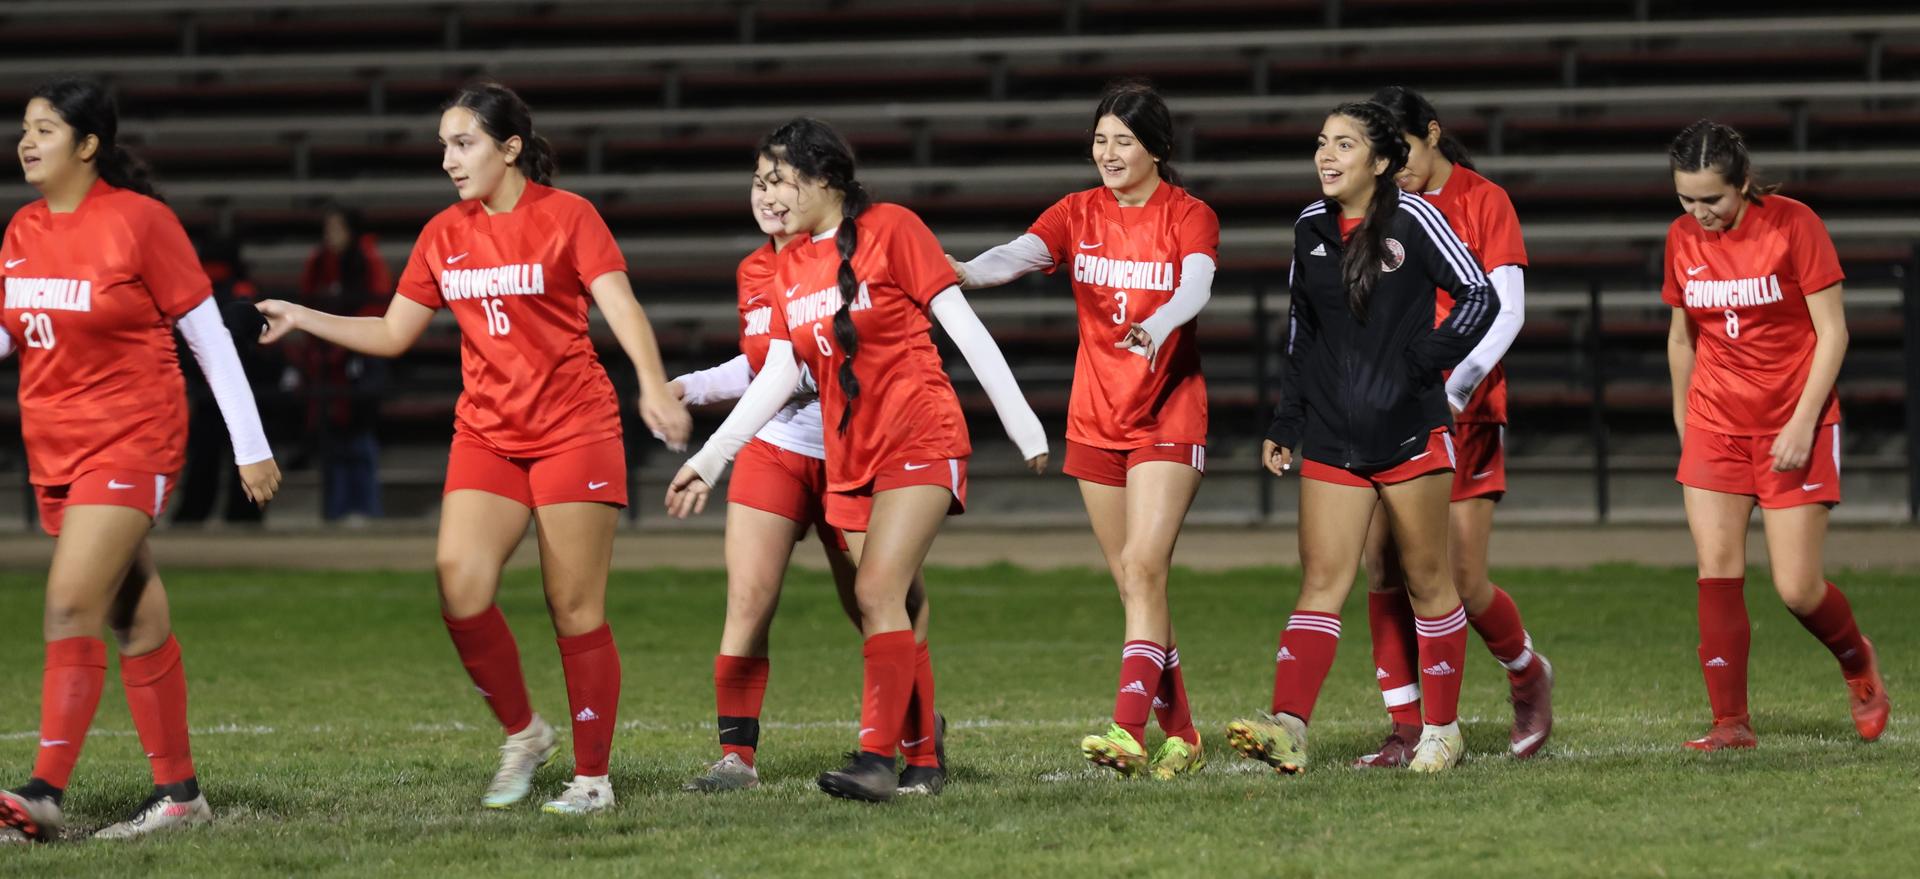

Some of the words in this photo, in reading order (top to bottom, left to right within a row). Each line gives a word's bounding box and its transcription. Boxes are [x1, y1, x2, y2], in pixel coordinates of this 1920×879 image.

[441, 263, 544, 301] CHOWCHILLA
[1074, 253, 1173, 291] CHOWCHILLA
[1112, 291, 1128, 325] 3
[1685, 274, 1783, 308] CHOWCHILLA
[20, 312, 56, 350] 20
[481, 298, 511, 336] 16
[1724, 309, 1739, 339] 8
[813, 322, 832, 356] 6
